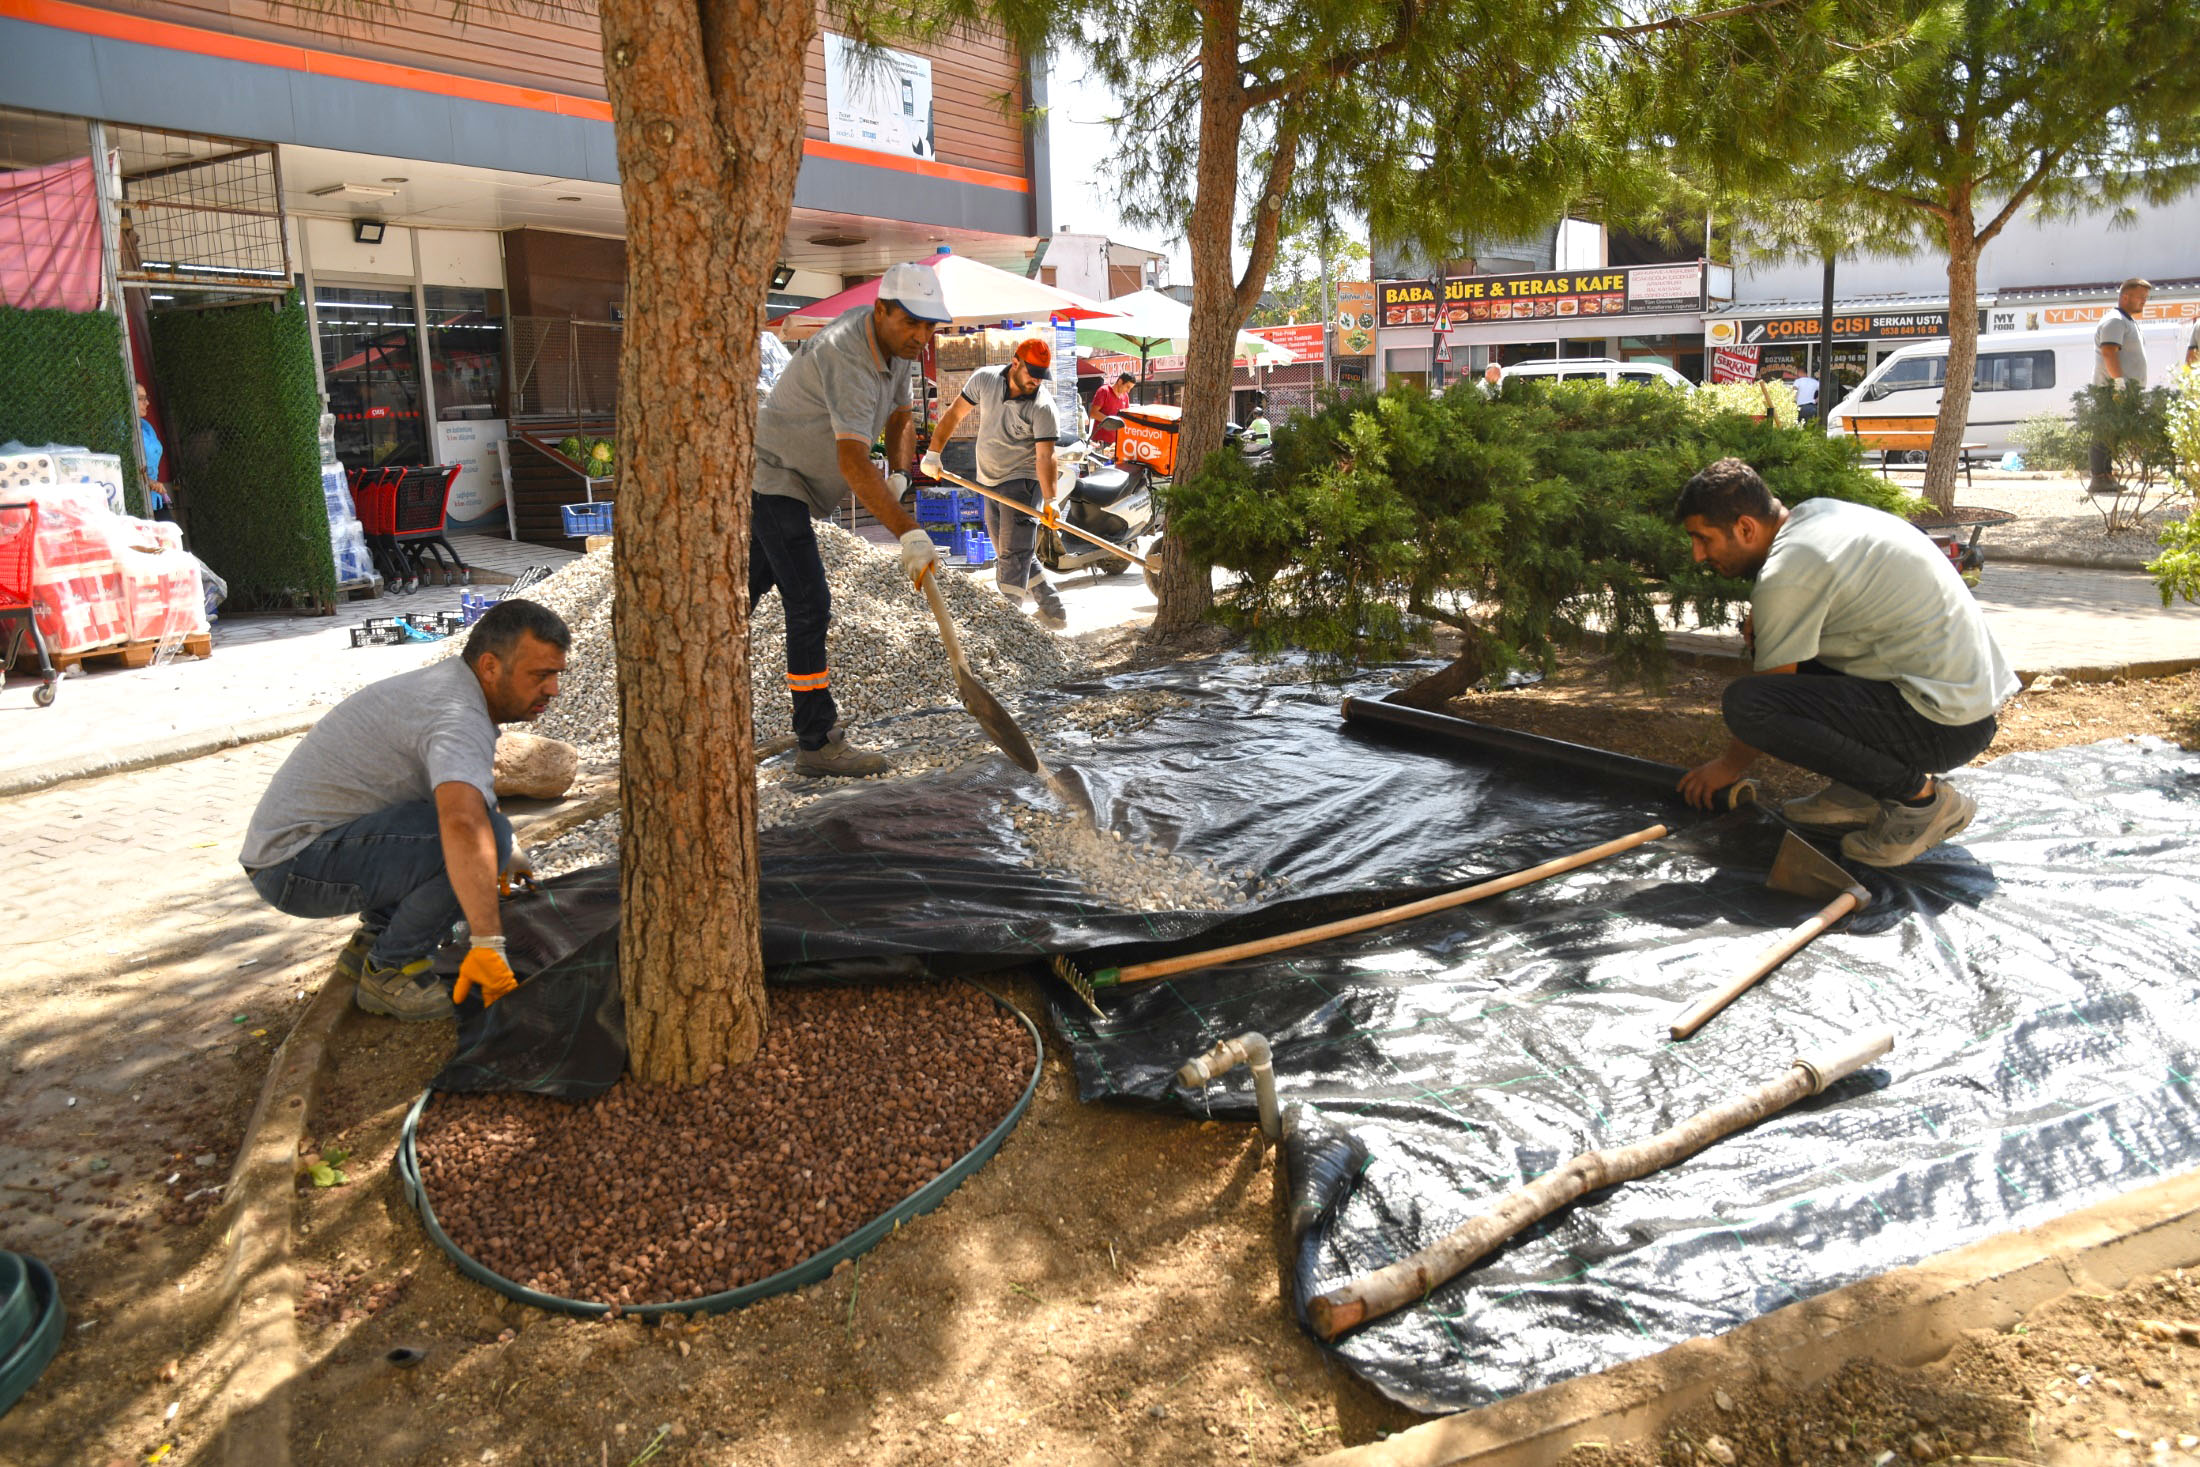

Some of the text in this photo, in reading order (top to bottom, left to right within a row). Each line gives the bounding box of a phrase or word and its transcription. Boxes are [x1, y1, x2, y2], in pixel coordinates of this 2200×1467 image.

[1386, 287, 1434, 304] BABA
[1444, 281, 1484, 300] BÜFE
[1490, 282, 1505, 297] &
[1508, 278, 1569, 296] TERAS
[1576, 275, 1624, 292] KAFE
[1873, 315, 1943, 327] SERKAN USTA
[1993, 313, 2015, 324] MY
[2049, 308, 2112, 323] YUNU
[2142, 305, 2172, 319] ET
[1766, 318, 1870, 339] ÇORBCISI
[1880, 327, 1899, 335] 0538
[1993, 323, 2015, 331] FOOD
[1124, 426, 1163, 440] trendyol
[1122, 438, 1158, 461] go
